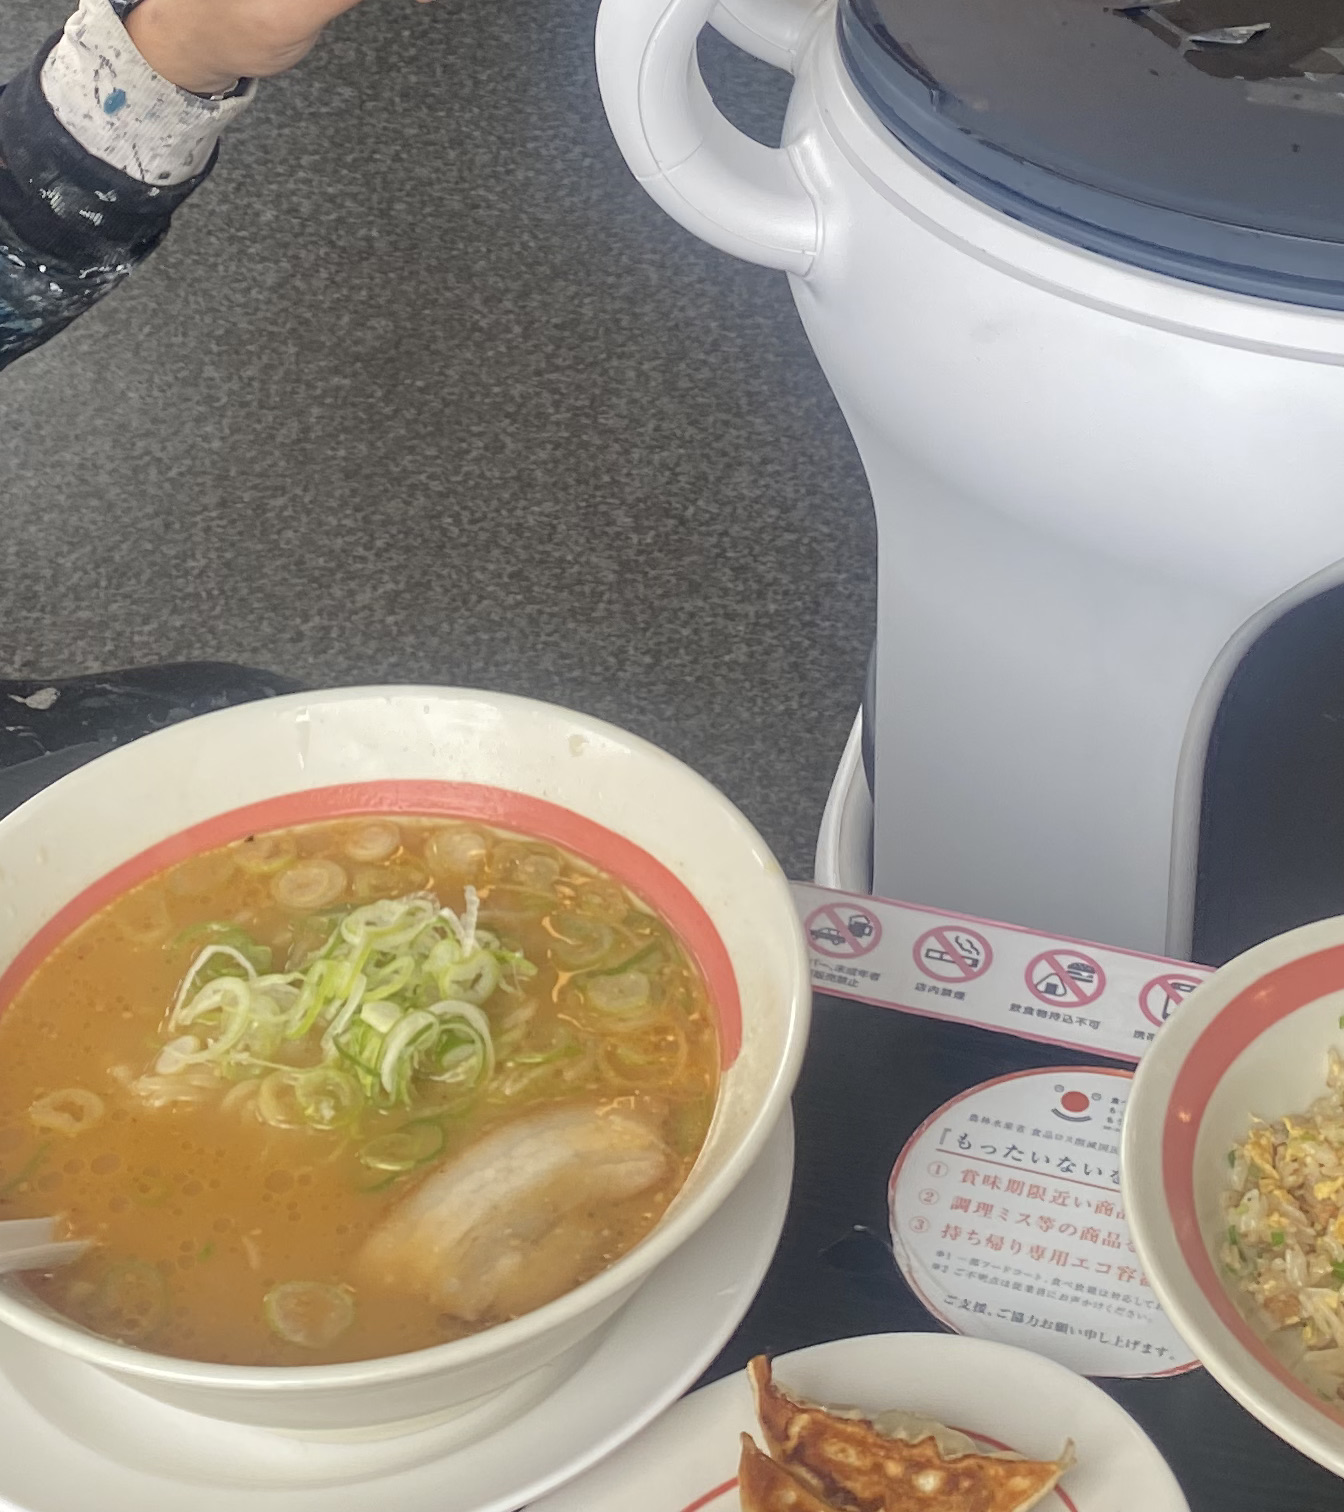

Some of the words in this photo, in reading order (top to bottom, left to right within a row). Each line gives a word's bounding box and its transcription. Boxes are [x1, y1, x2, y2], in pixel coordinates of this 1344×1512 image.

[1009, 1003, 1101, 1030] 飲食物持込不可
